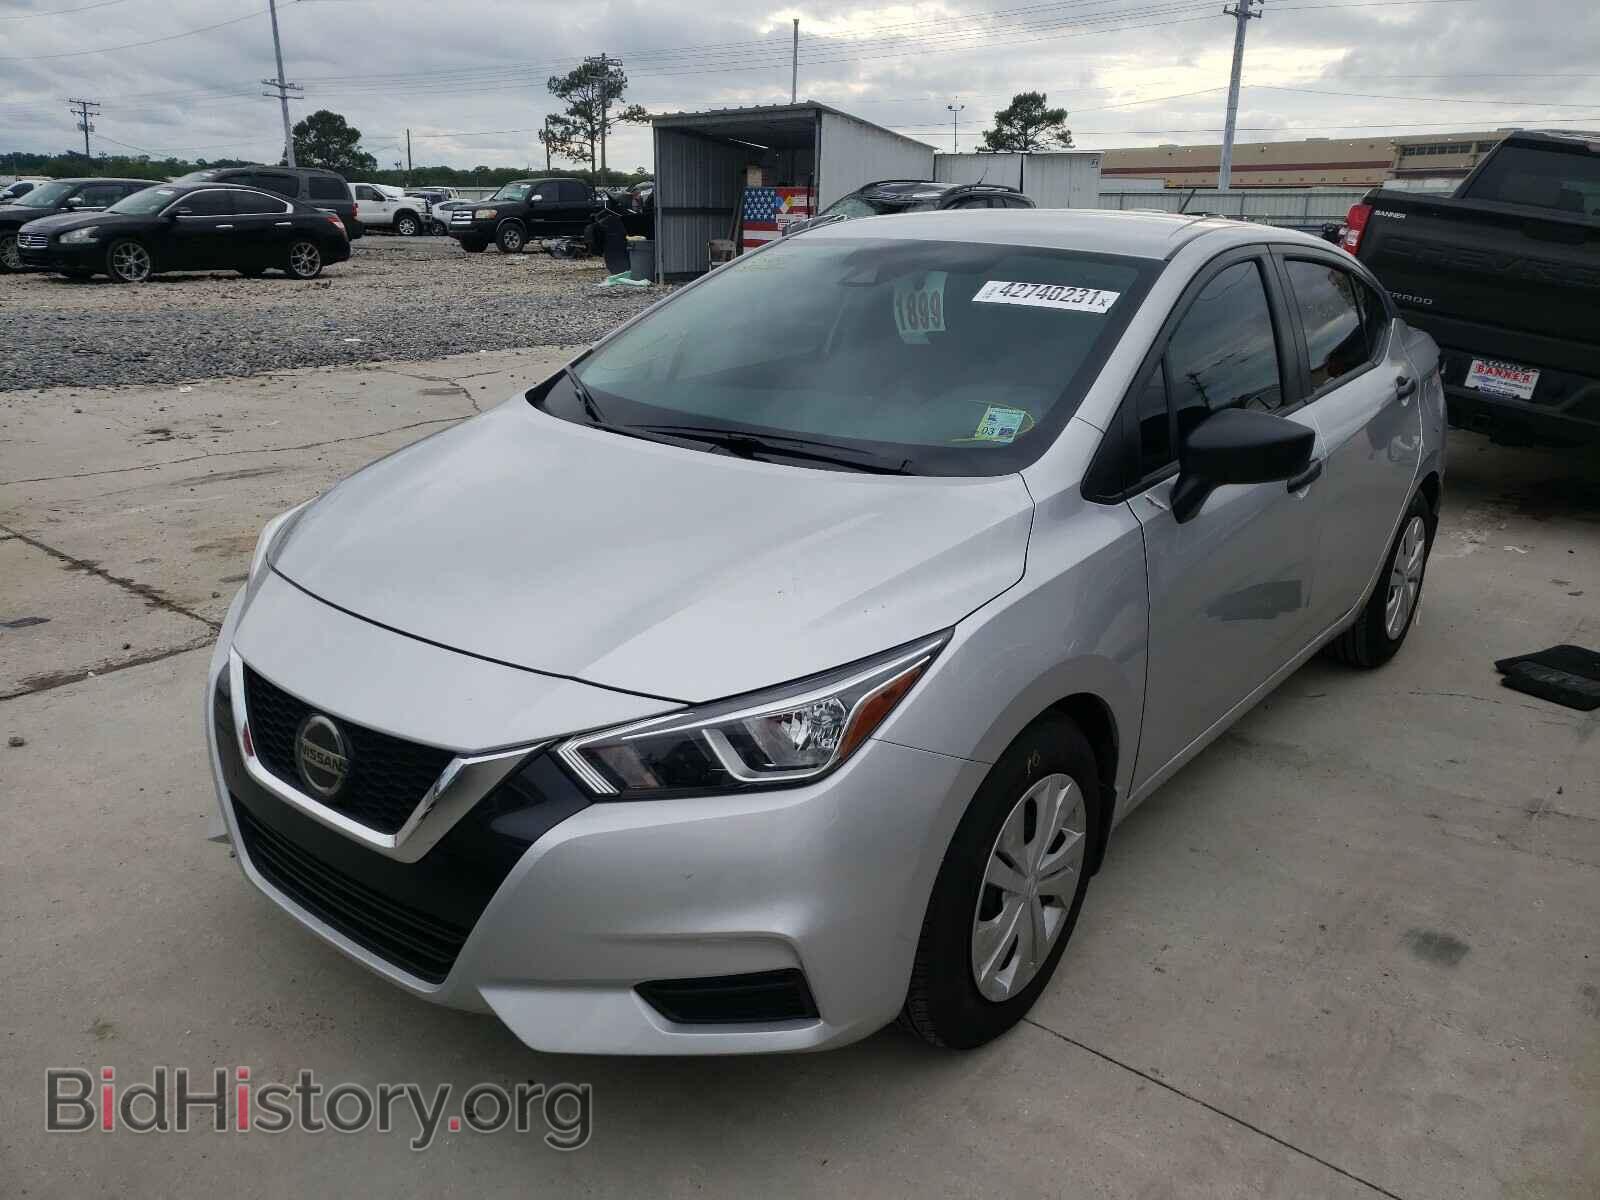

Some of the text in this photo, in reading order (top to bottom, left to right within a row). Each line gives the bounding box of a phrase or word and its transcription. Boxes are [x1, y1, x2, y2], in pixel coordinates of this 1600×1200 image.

[1374, 209, 1407, 219] BANNER
[999, 281, 1101, 305] 42740231
[1386, 291, 1433, 305] RADO
[895, 290, 942, 330] 1899
[1476, 363, 1532, 384] BANNER
[304, 743, 343, 772] NISSAN
